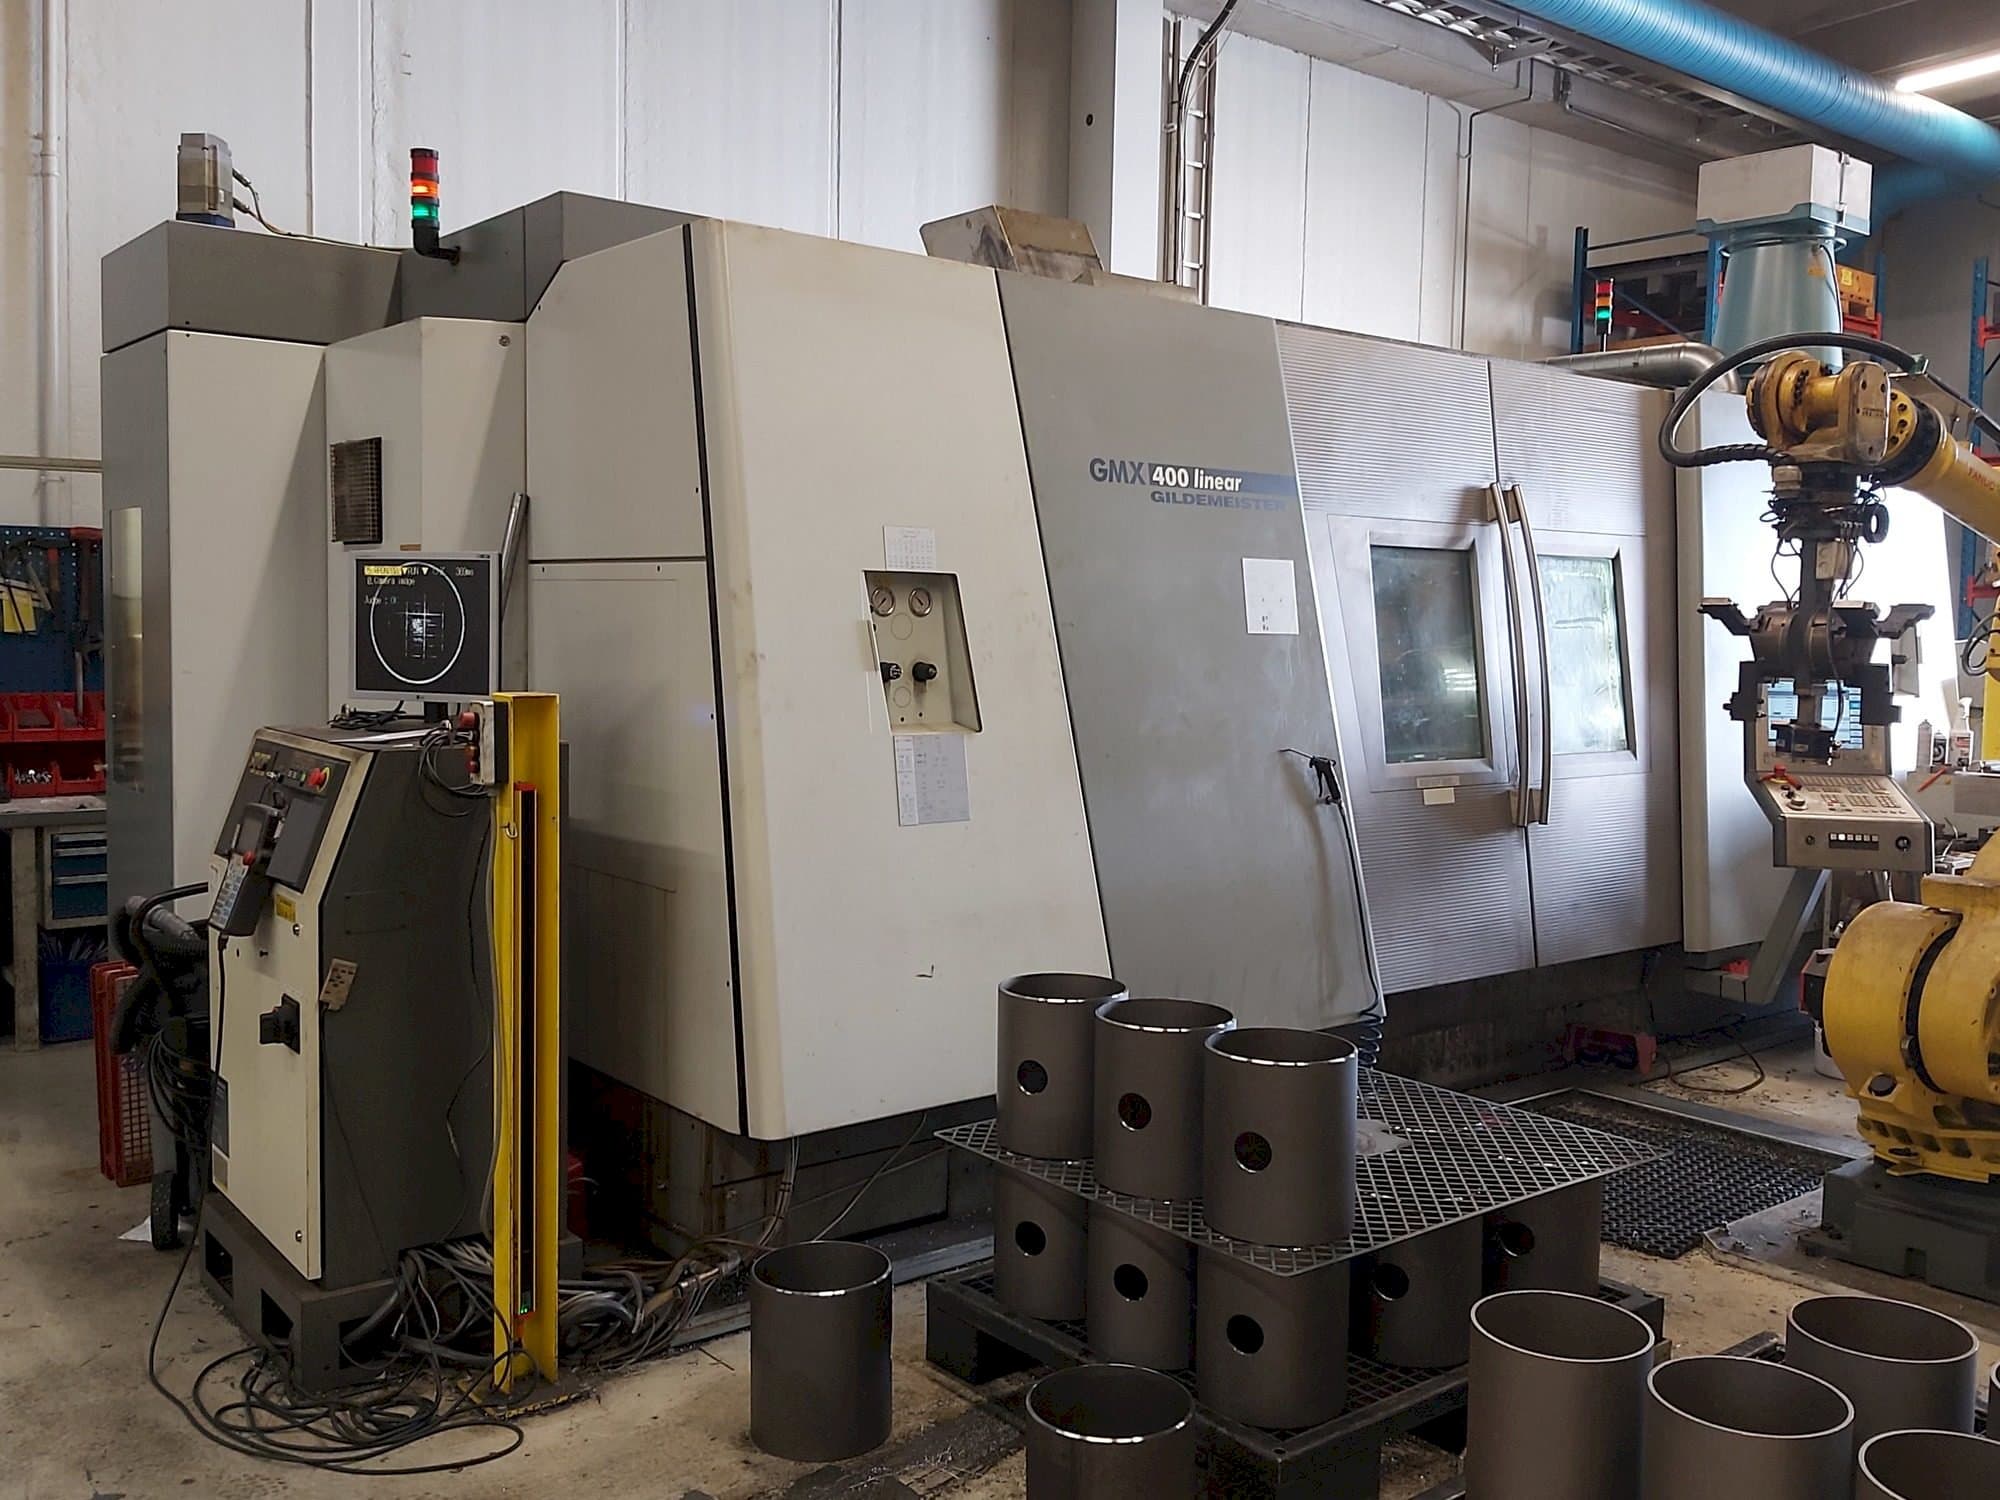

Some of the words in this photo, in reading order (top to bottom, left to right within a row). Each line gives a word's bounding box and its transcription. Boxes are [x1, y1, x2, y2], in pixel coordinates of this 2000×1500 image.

[1089, 457, 1146, 485] GMX
[1152, 466, 1189, 487] 400
[1194, 467, 1242, 492] linear
[1150, 490, 1286, 512] GILDEMEISTER
